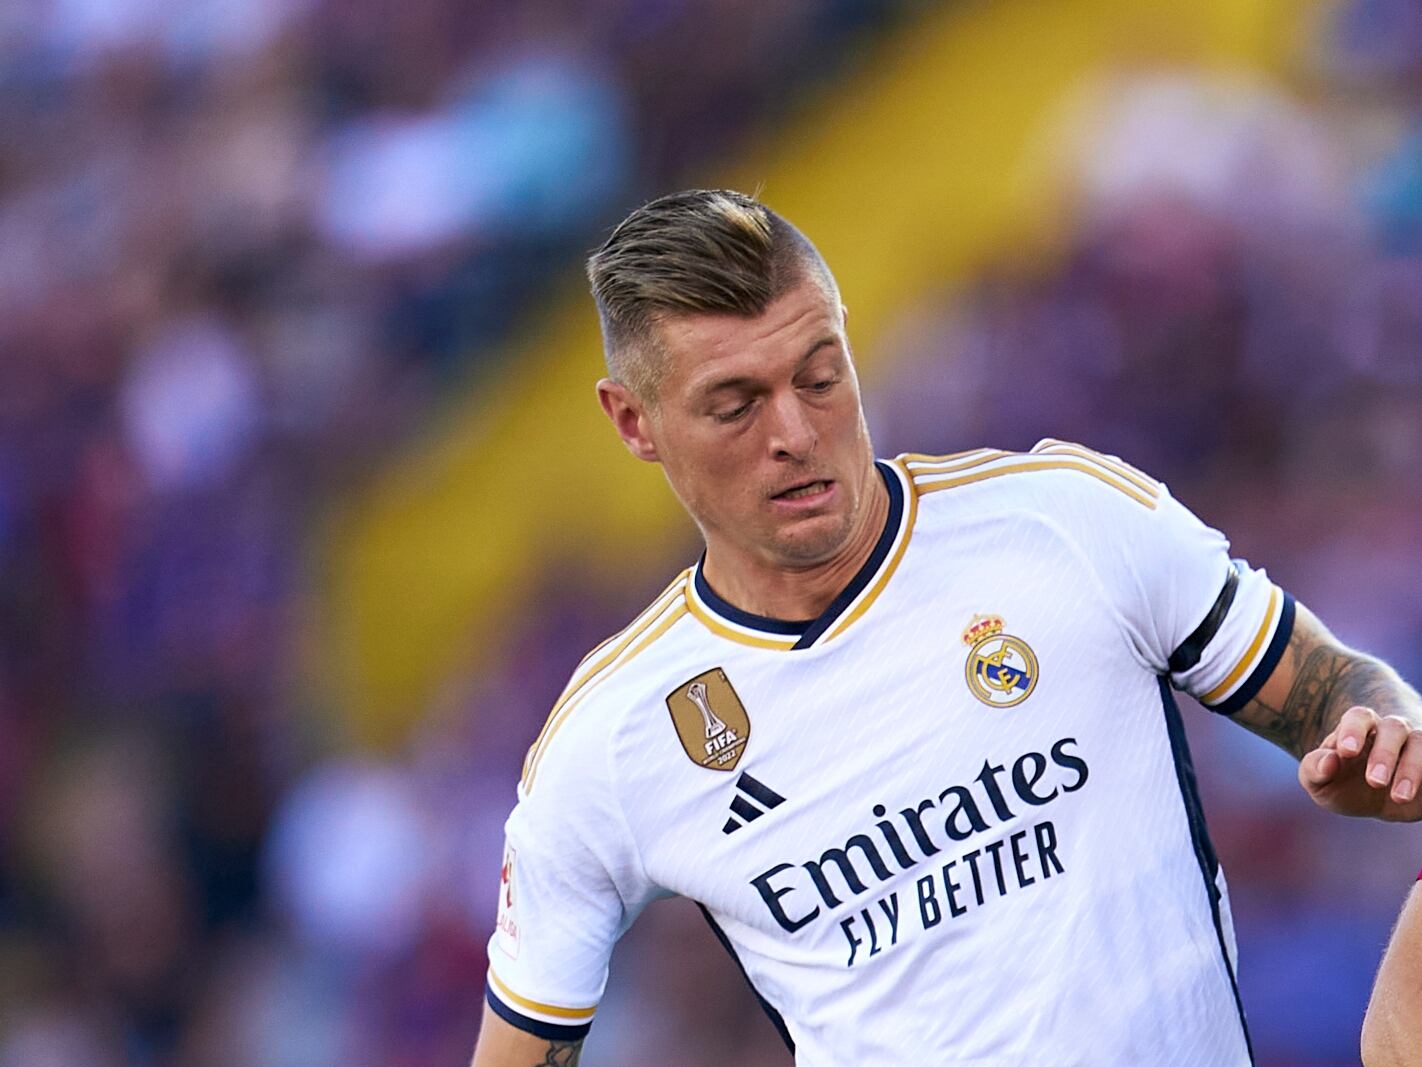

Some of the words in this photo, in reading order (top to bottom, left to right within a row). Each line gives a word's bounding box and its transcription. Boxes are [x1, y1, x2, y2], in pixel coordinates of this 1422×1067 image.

[705, 730, 738, 755] FIFA
[717, 750, 736, 765] 2022
[750, 737, 1089, 934] Emirates
[839, 892, 899, 967] FLY
[916, 820, 1065, 930] BETTER
